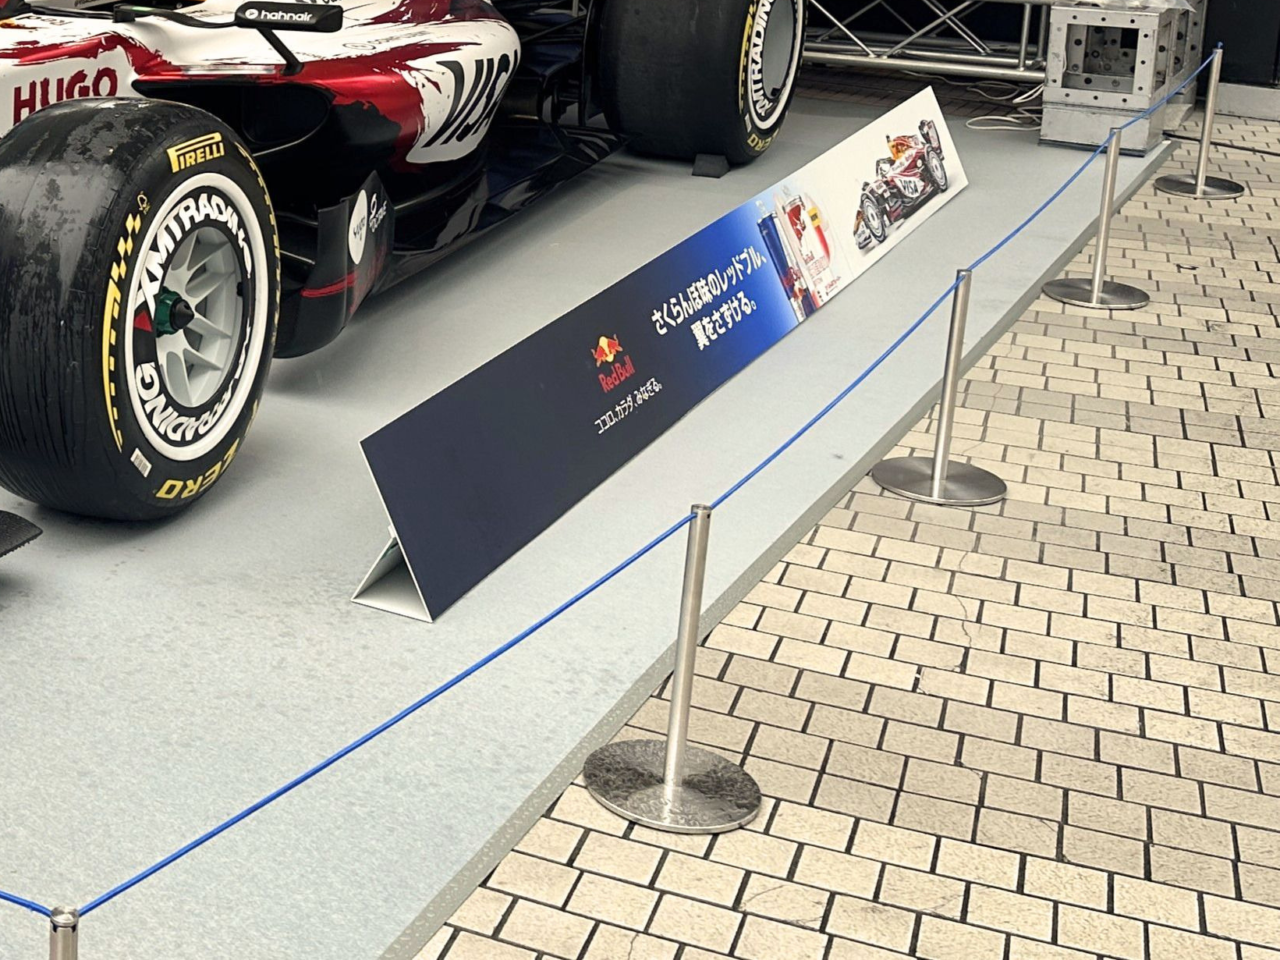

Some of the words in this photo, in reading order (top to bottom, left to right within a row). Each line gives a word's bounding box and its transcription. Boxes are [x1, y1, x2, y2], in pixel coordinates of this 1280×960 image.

[260, 11, 313, 22] hahnair
[13, 67, 118, 125] HUGO
[166, 131, 224, 172] PIRELLI
[651, 246, 767, 335] さくらんぼ味のレッドブル、
[690, 290, 757, 351] 翼をさずける。
[597, 366, 620, 393] Red
[618, 355, 637, 384] Bull
